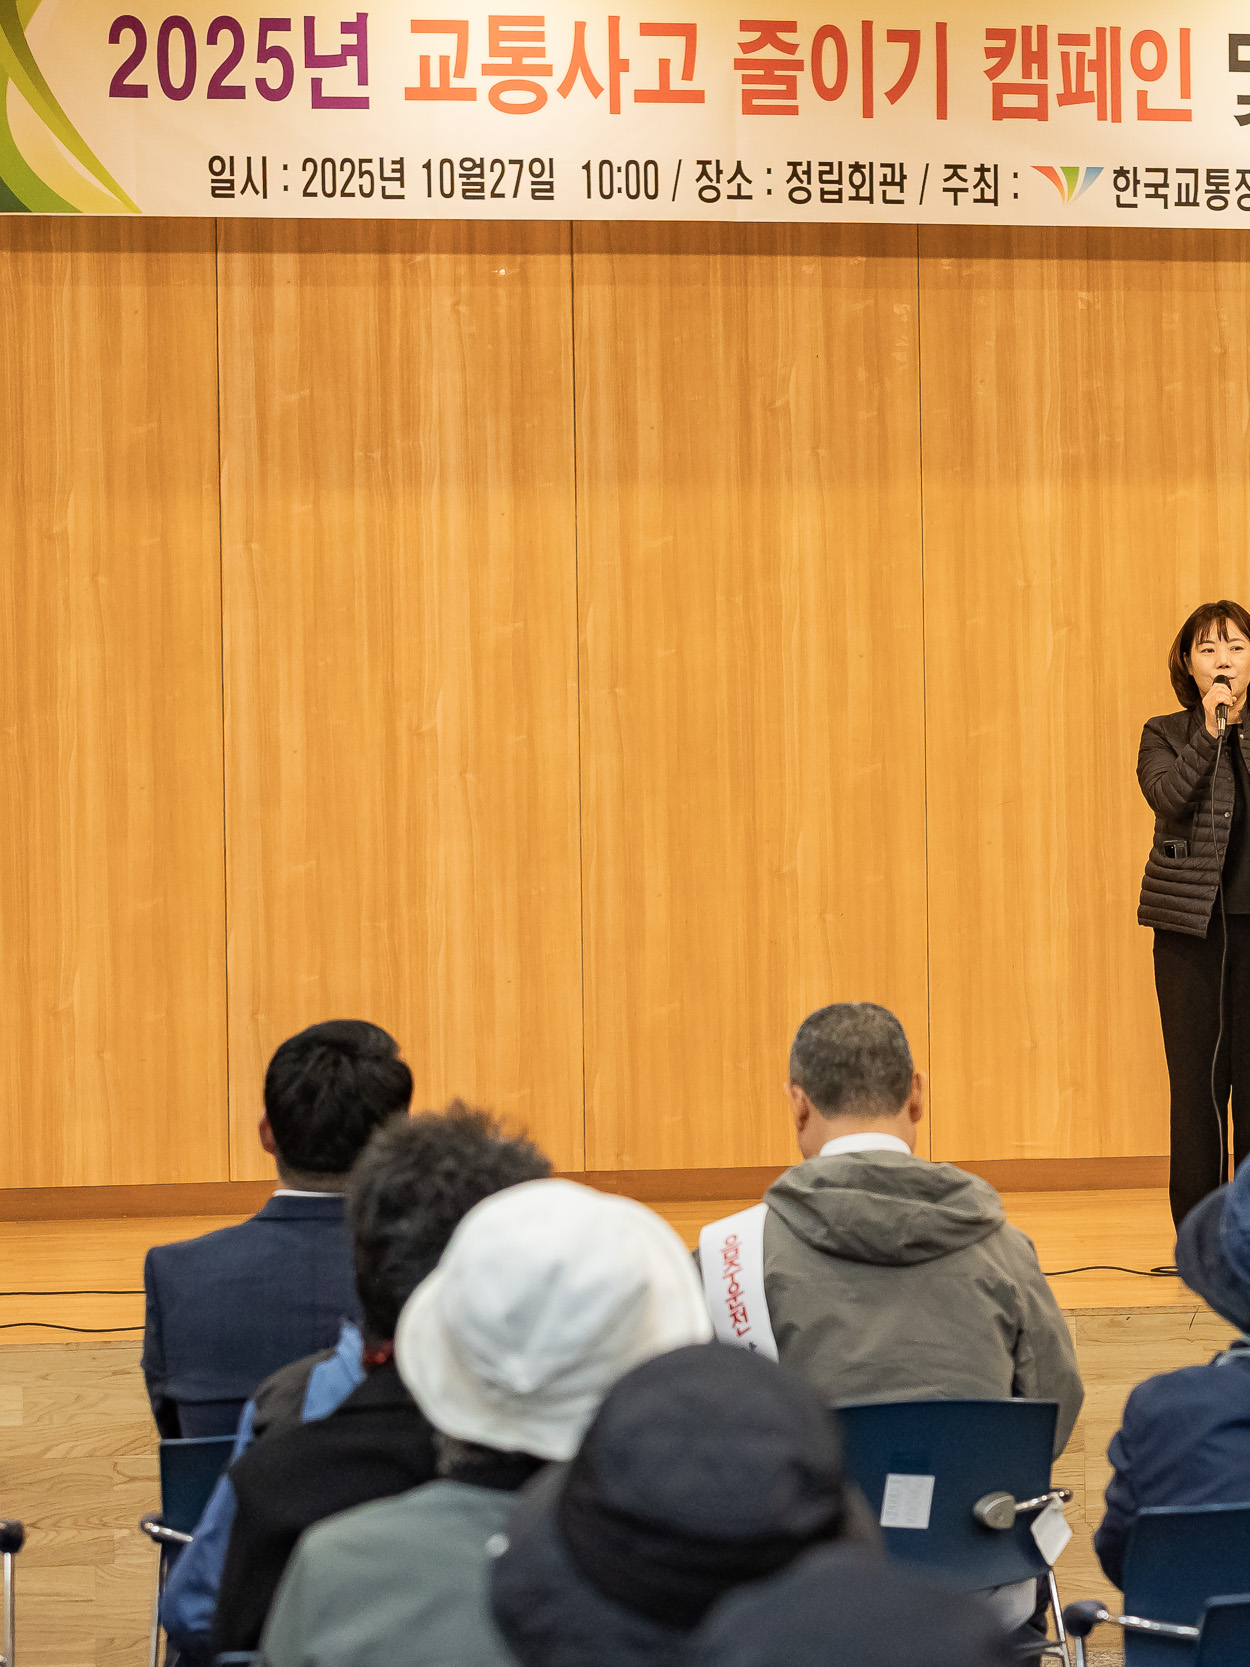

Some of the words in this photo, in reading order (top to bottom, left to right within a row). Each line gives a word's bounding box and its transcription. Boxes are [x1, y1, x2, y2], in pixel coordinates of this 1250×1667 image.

[108, 13, 369, 109] 2025년
[405, 15, 705, 114] 교통사고
[734, 20, 947, 120] 줄이기
[983, 24, 1192, 123] 캠페인
[208, 155, 267, 199] 일시
[302, 157, 405, 199] 2025년
[422, 157, 554, 200] 10월27일
[582, 160, 659, 200] 10:00
[695, 159, 753, 203] 장소
[786, 161, 907, 204] 정립회관
[942, 163, 998, 206] 주최
